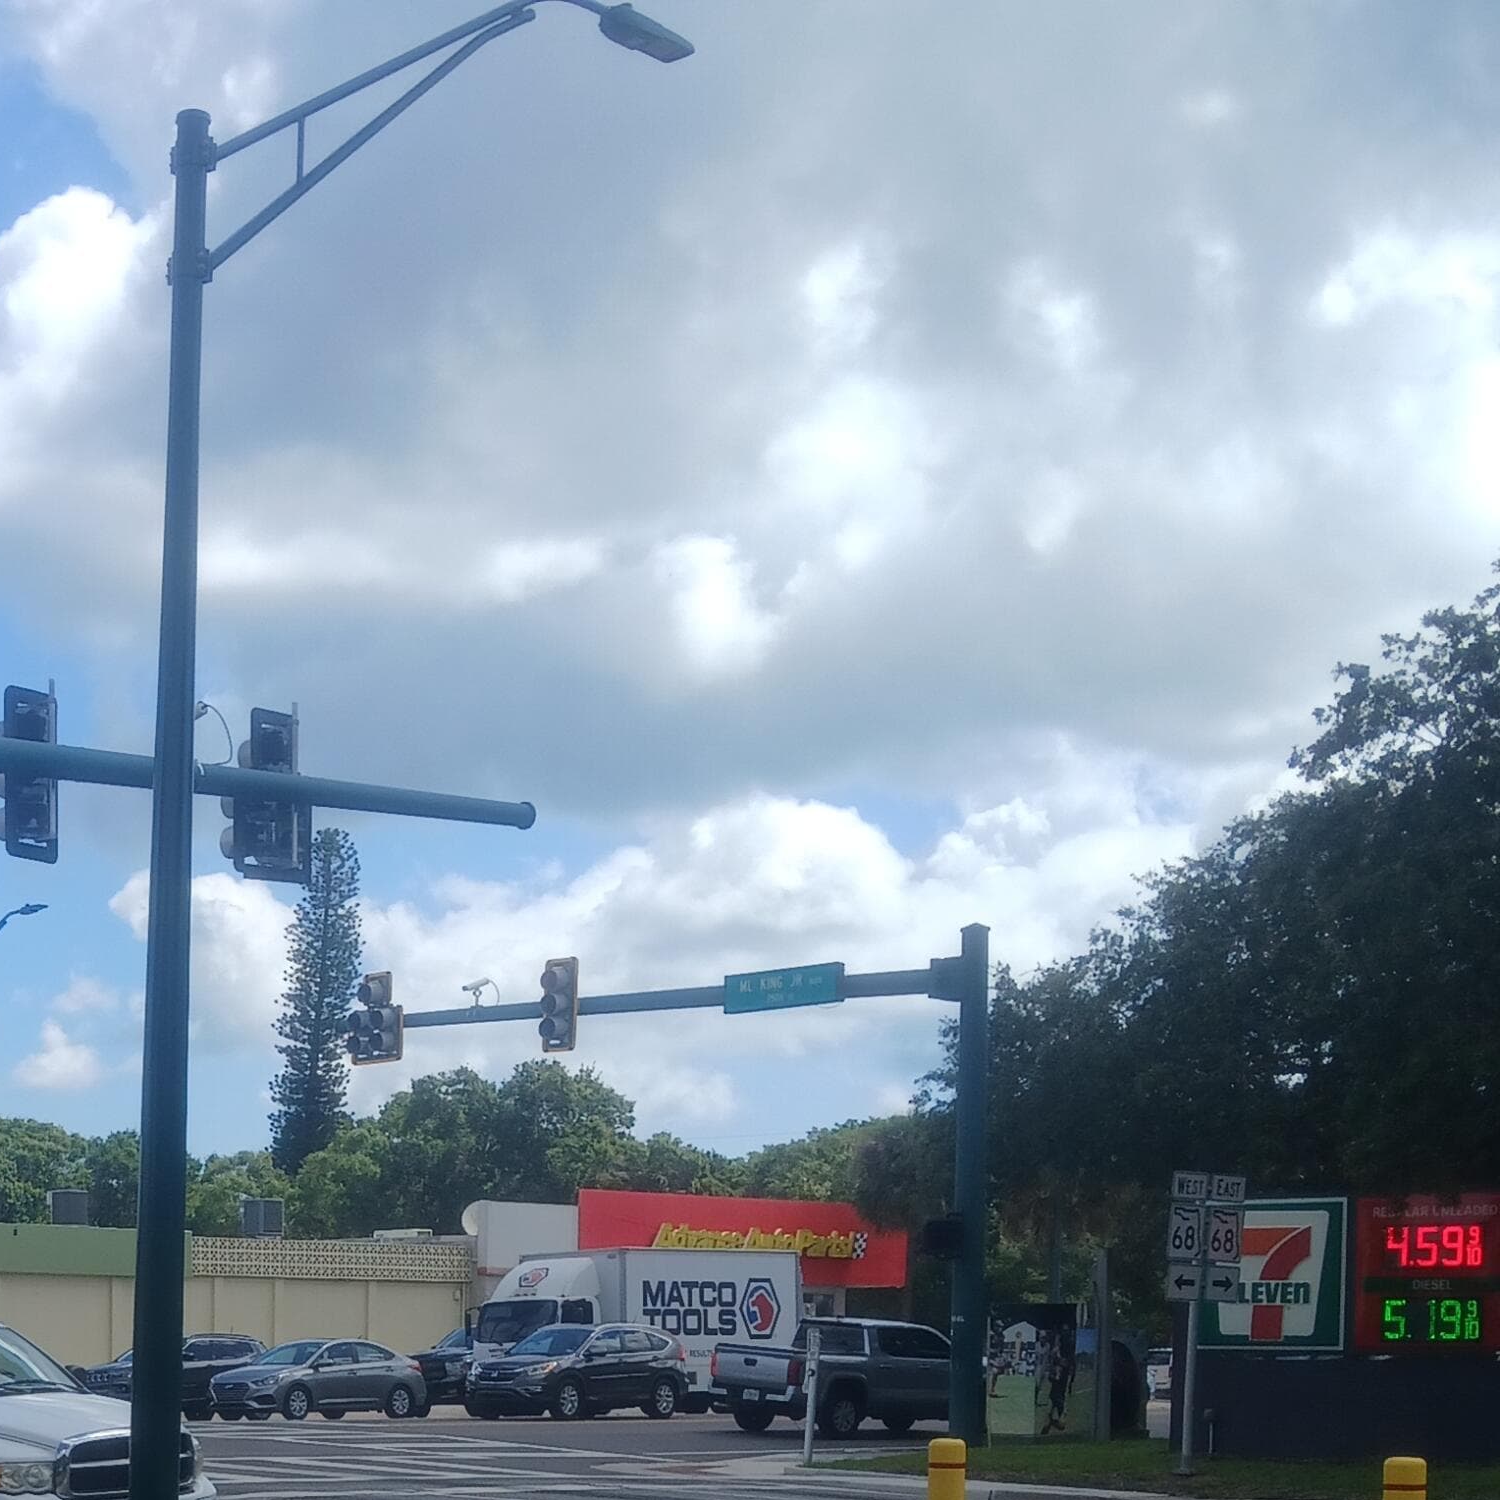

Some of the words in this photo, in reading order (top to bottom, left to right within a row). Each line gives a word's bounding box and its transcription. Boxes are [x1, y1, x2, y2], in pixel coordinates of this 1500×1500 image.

[760, 976, 783, 990] KING
[1177, 1176, 1205, 1196] WEST
[1217, 1178, 1241, 1198] EAST
[1372, 1206, 1428, 1218] RELAR
[1171, 1226, 1196, 1251] 68
[1211, 1228, 1235, 1254] 68
[1386, 1225, 1464, 1267] 4.59
[642, 1280, 737, 1308] MATCO
[1241, 1226, 1312, 1341] 7
[1412, 1279, 1453, 1291] DIESEL
[642, 1308, 737, 1336] TOOLS
[1384, 1299, 1461, 1340] 5.19
